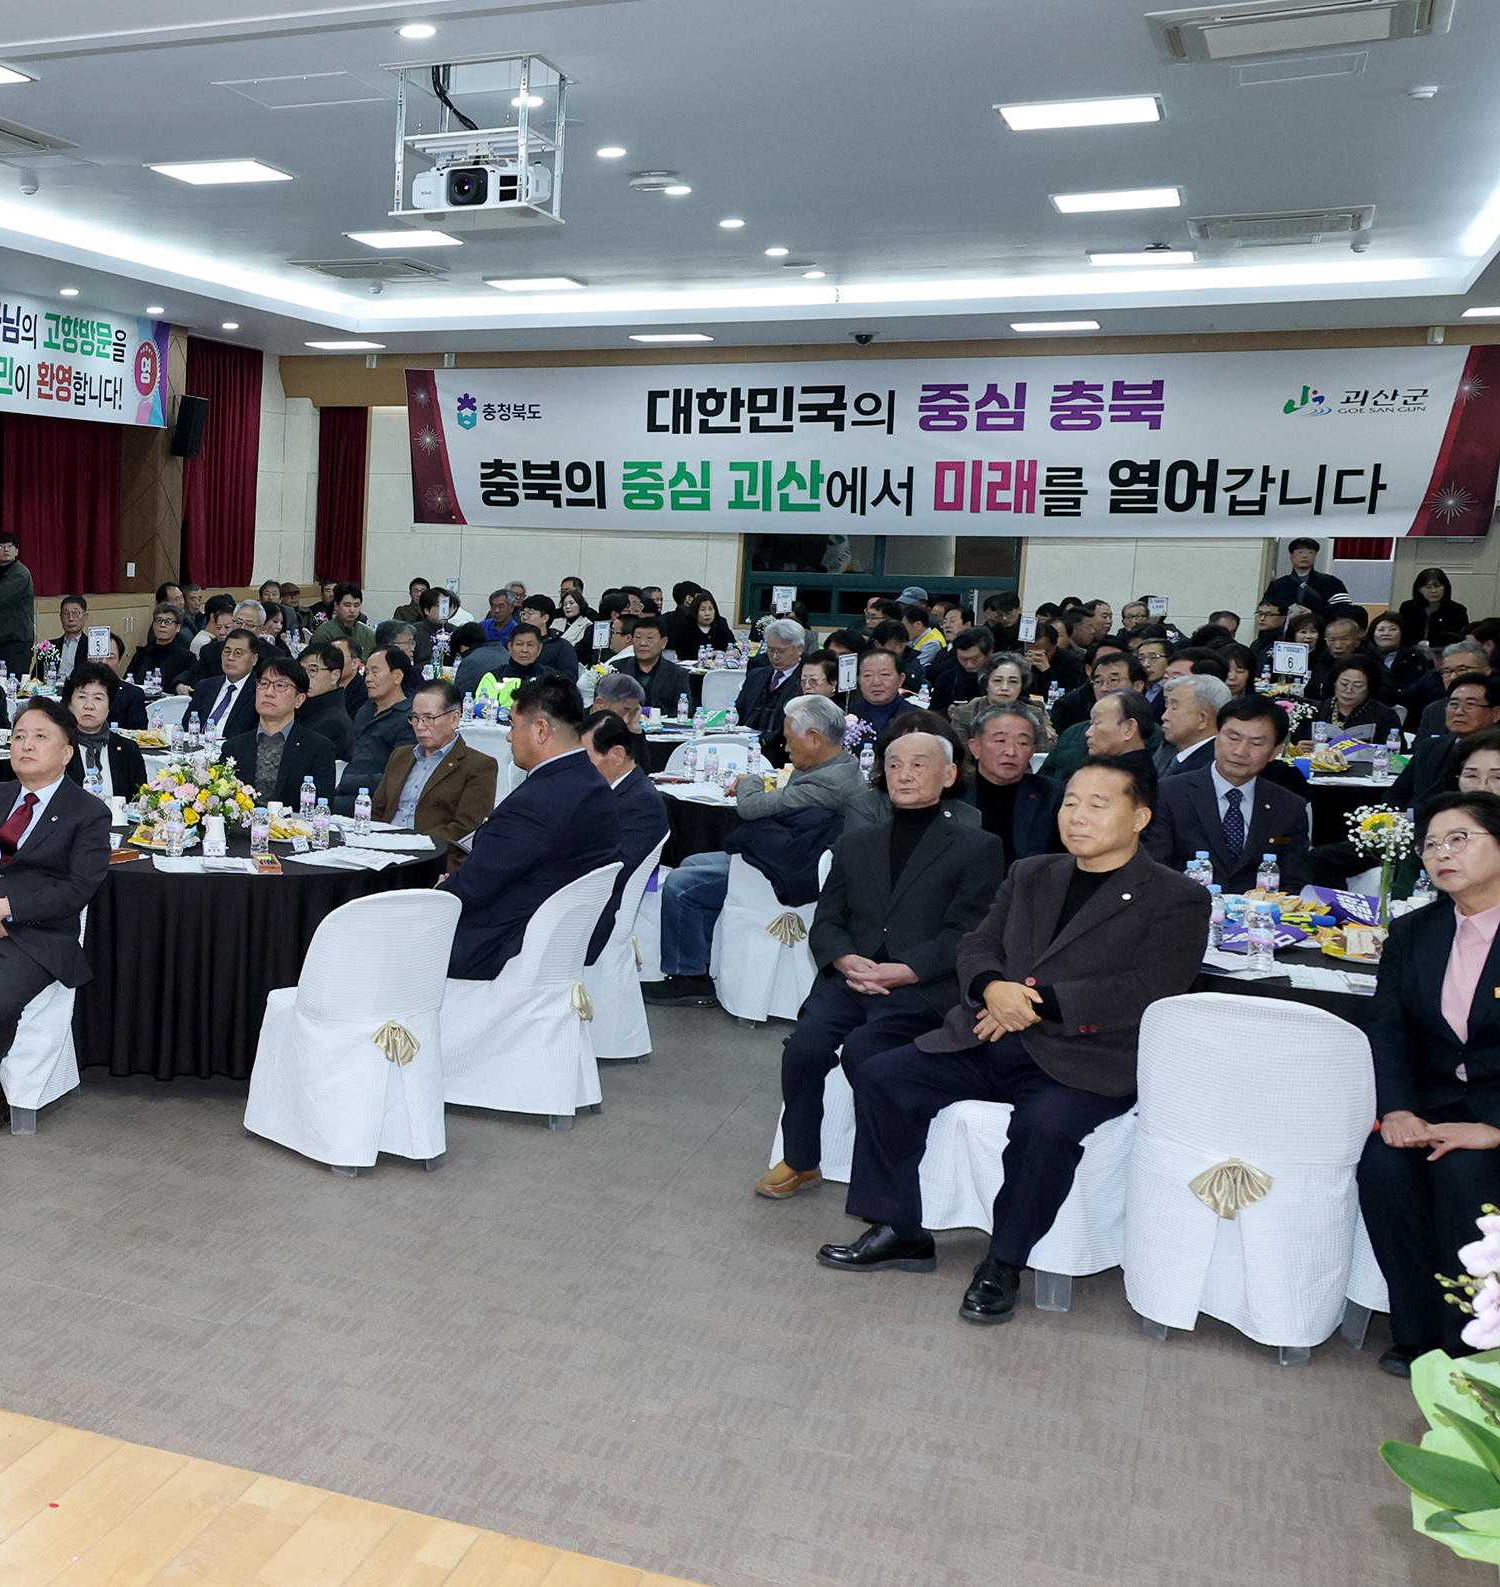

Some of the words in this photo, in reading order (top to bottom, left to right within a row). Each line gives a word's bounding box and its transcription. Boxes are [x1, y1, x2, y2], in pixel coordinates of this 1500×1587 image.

[43, 312, 127, 363] 고향방문을
[140, 356, 153, 384] 영
[36, 361, 123, 410] 환영합니다!
[1340, 389, 1429, 406] 괴산군
[482, 403, 542, 421] 충청북도
[646, 385, 896, 434] 대한민국의
[918, 383, 1027, 432] 중심
[1050, 379, 1165, 431] 충북
[479, 459, 607, 510] 충북의
[622, 460, 711, 512] 중심
[728, 459, 915, 516] 괴산에서
[934, 459, 1088, 516] 미래를
[1107, 458, 1388, 516] 열어갑니다
[95, 641, 101, 652] 5
[1288, 657, 1293, 668] 6
